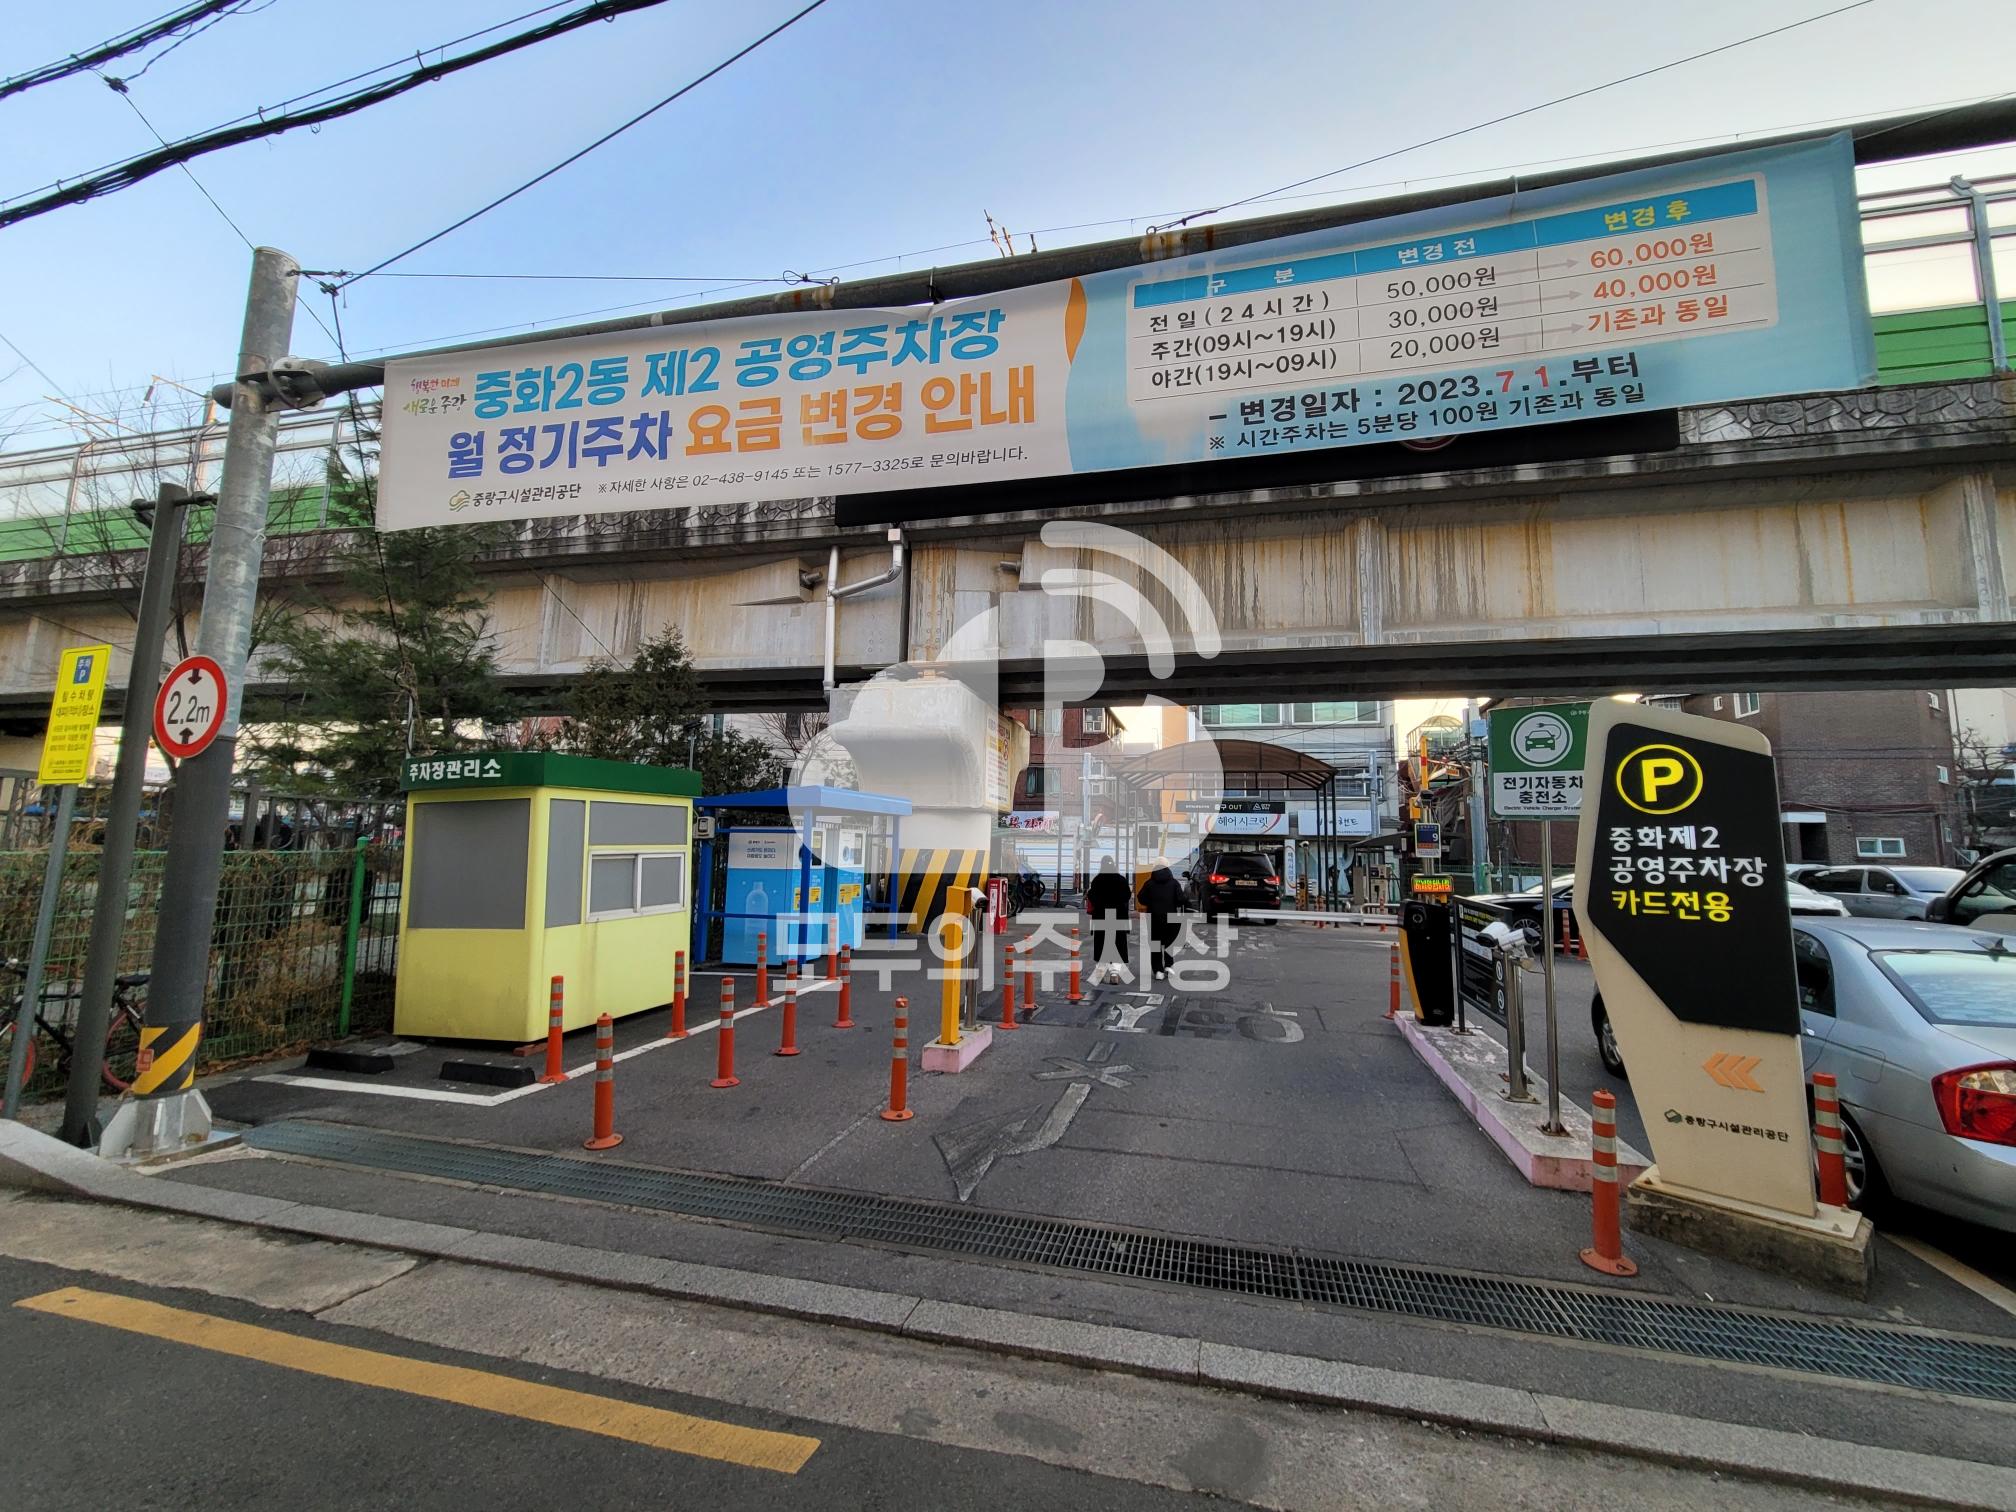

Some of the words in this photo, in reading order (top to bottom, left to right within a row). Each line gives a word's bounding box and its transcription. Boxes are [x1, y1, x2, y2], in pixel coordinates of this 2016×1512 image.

[1603, 205, 1656, 232] 변경
[1665, 199, 1693, 223] 후
[1397, 243, 1444, 266] 변경
[1453, 236, 1478, 256] 전
[1589, 231, 1715, 269] 60,000원
[1386, 266, 1497, 300] 50,000원
[1592, 263, 1718, 300] 40,000원
[1388, 296, 1500, 329] 30,000원
[1587, 303, 1665, 333] 기존과
[1676, 294, 1729, 324] 동일
[1389, 326, 1501, 360] 20,000원
[473, 355, 629, 419] 중화2동
[640, 346, 722, 397] 제2
[734, 308, 1007, 388] 공영주차장
[403, 397, 439, 416] 새로운
[441, 393, 468, 414] 중랑
[1236, 420, 1348, 449] 시간주차는
[1357, 411, 1419, 435] 5분당
[1428, 399, 1499, 426] 100원
[1508, 388, 1583, 417] 기존과
[1593, 382, 1645, 408] 동일
[1239, 388, 1361, 426] 변경일자
[447, 430, 485, 480] 월
[497, 410, 673, 475] 정기주차
[685, 396, 783, 456] 요금
[800, 381, 903, 446] 변경
[920, 364, 1035, 434] 안내
[610, 479, 647, 495] 자세한
[650, 474, 689, 491] 사항은
[692, 467, 789, 488] 02-438-9145
[793, 464, 820, 480] 또는
[826, 455, 925, 476] 1577-3325로
[929, 445, 1029, 469] 문의바랍니다.
[472, 482, 582, 508] 중랑구시설관리공단
[167, 690, 211, 725] 2.2m
[408, 757, 502, 782] 주차장관리소
[1503, 775, 1583, 790] 전기자동차
[1639, 758, 1685, 802] P
[1519, 791, 1567, 804] 충전소
[1218, 816, 1237, 827] 헤어
[1239, 816, 1269, 828] 시크릿
[1432, 833, 1439, 842] 9
[1609, 825, 1721, 852] 중화제2
[1609, 855, 1767, 888] 공영주차장
[1611, 889, 1734, 923] 카드전용
[1685, 1115, 1789, 1142] 중랑구시설관리공단
